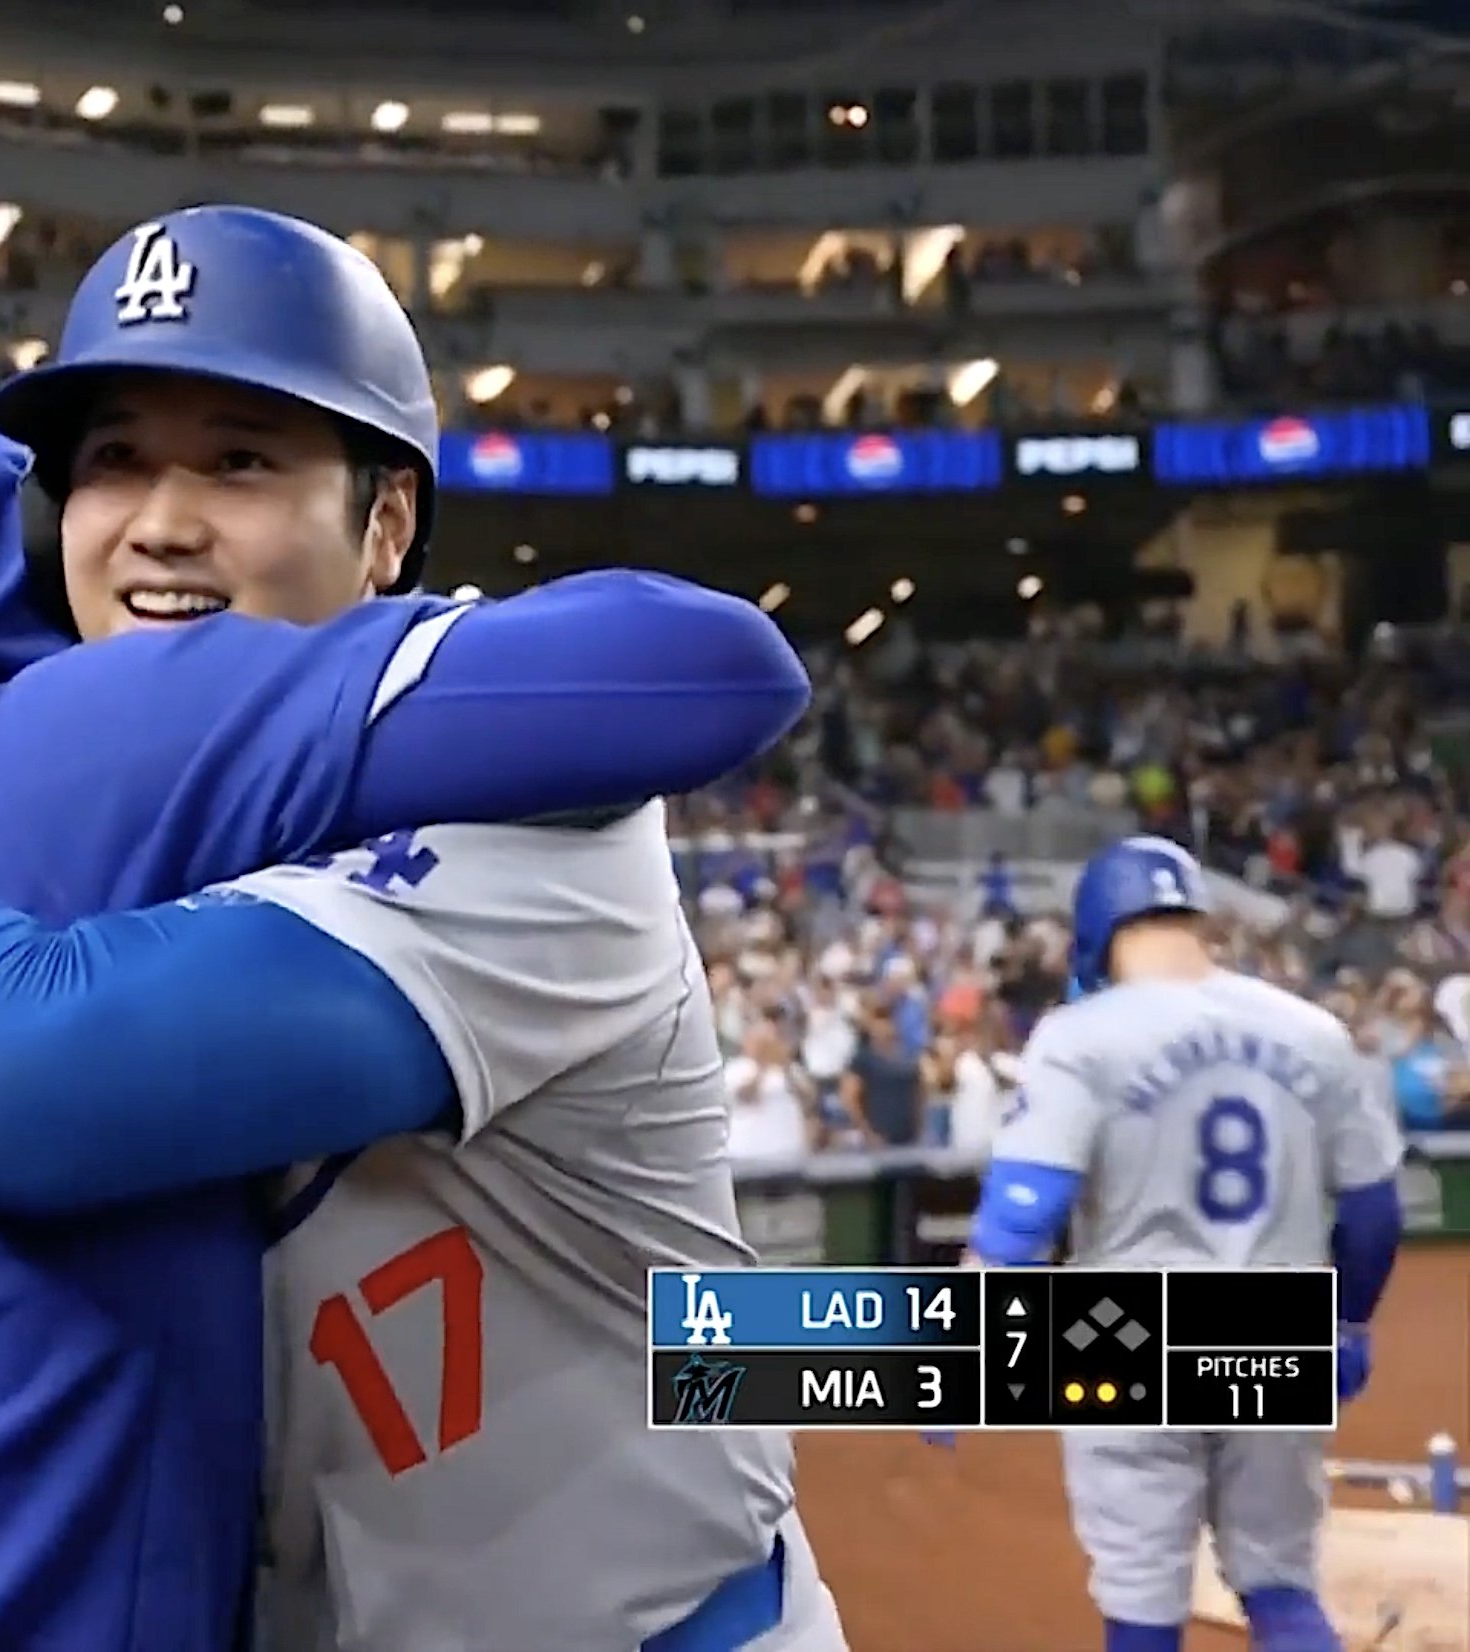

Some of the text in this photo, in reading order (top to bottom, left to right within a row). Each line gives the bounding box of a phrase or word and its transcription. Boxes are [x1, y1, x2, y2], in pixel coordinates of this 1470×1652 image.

[114, 222, 195, 324] LA
[1196, 1096, 1267, 1225] 8
[309, 1224, 483, 1479] 17
